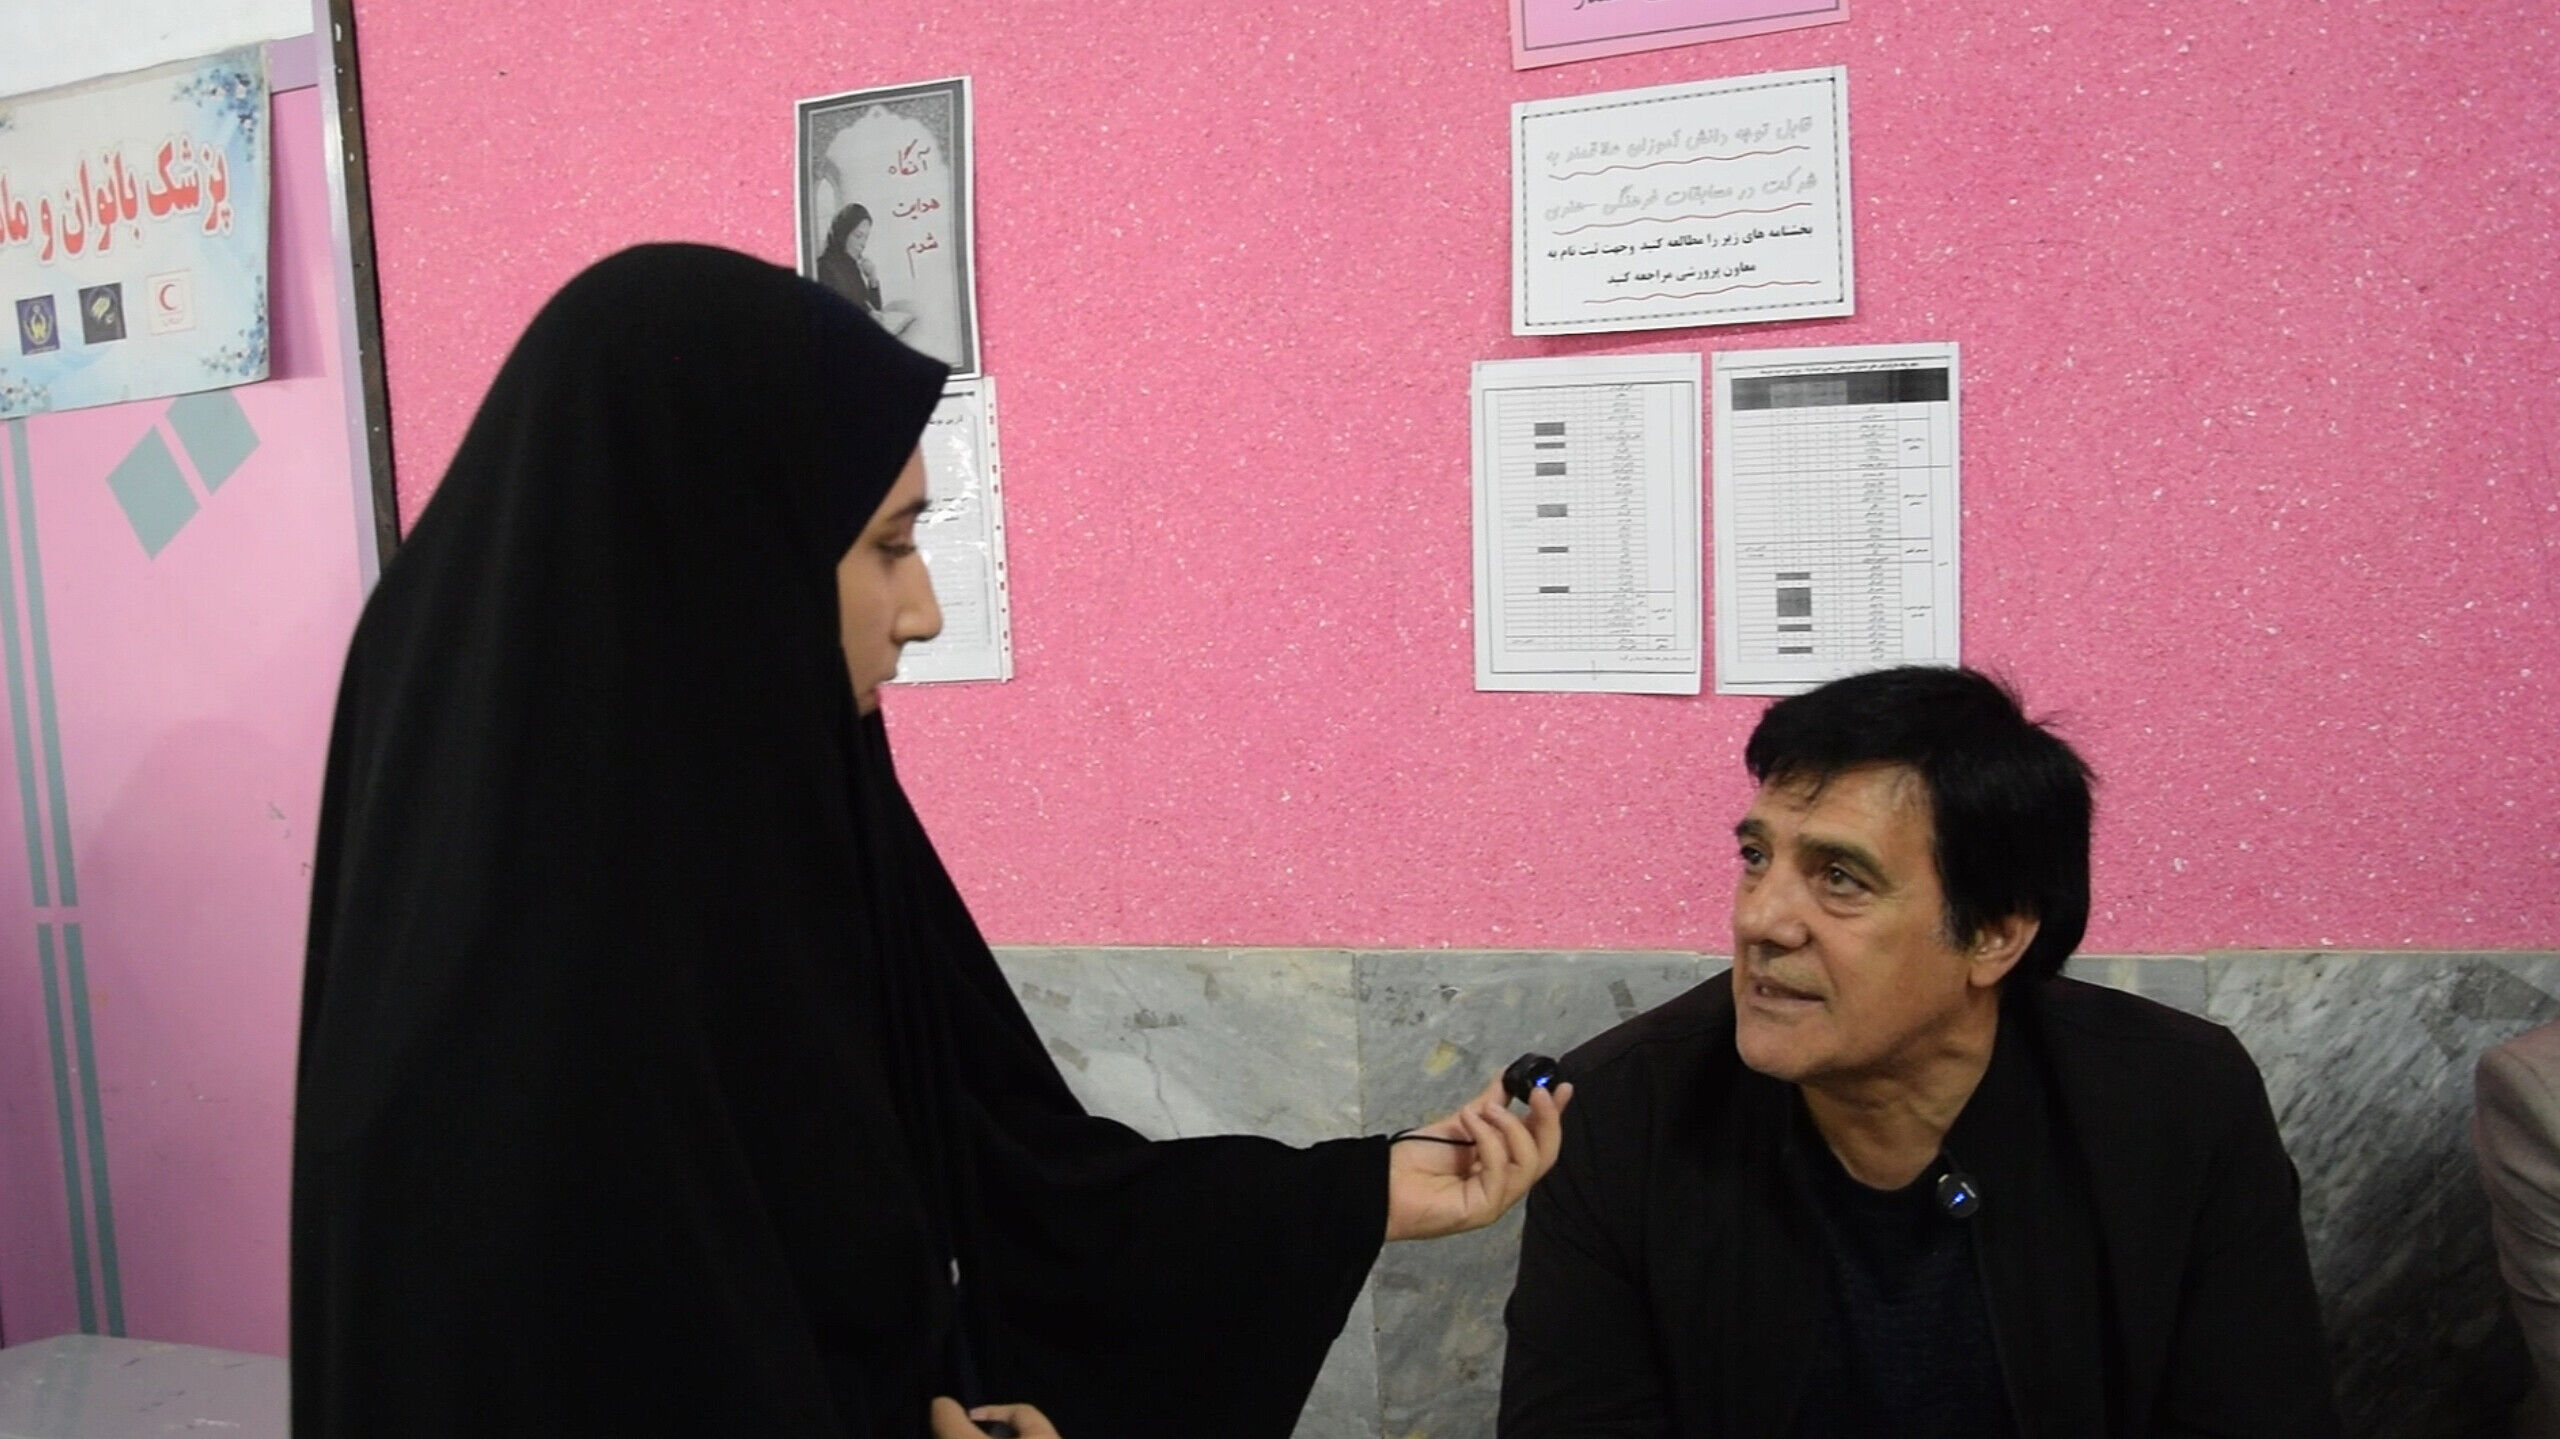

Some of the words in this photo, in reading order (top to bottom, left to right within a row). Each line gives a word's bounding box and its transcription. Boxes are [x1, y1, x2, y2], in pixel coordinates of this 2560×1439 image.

[1736, 122, 1769, 144] توجه
[1776, 115, 1813, 141] قابل
[1626, 128, 1682, 158] آموزان
[1686, 128, 1728, 151] دانش
[887, 138, 931, 176] آنگاه
[1545, 150, 1560, 167] به
[146, 138, 231, 231] پزشک
[1762, 165, 1818, 195] شرکت
[1602, 183, 1659, 216] فرهنگی
[1664, 184, 1733, 207] مسابقات
[1737, 185, 1757, 201] در
[0, 172, 29, 244] ما
[62, 150, 140, 255] بانوان
[892, 197, 940, 220] هدایت
[41, 197, 54, 262] و
[1742, 228, 1765, 245] های
[1768, 224, 1813, 238] بخشنامه
[1640, 236, 1664, 254] کنید
[1667, 234, 1704, 248] مطالعه
[1706, 232, 1718, 248] را
[1721, 233, 1740, 248] زیر
[906, 231, 939, 280] شدم
[1547, 249, 1558, 261] به
[1560, 245, 1576, 261] نام
[1579, 242, 1599, 258] ثبت
[1634, 268, 1673, 284] مراجعه
[1676, 265, 1720, 282] پرورشی
[1722, 260, 1756, 278] معاون
[1607, 270, 1631, 288] کنید
